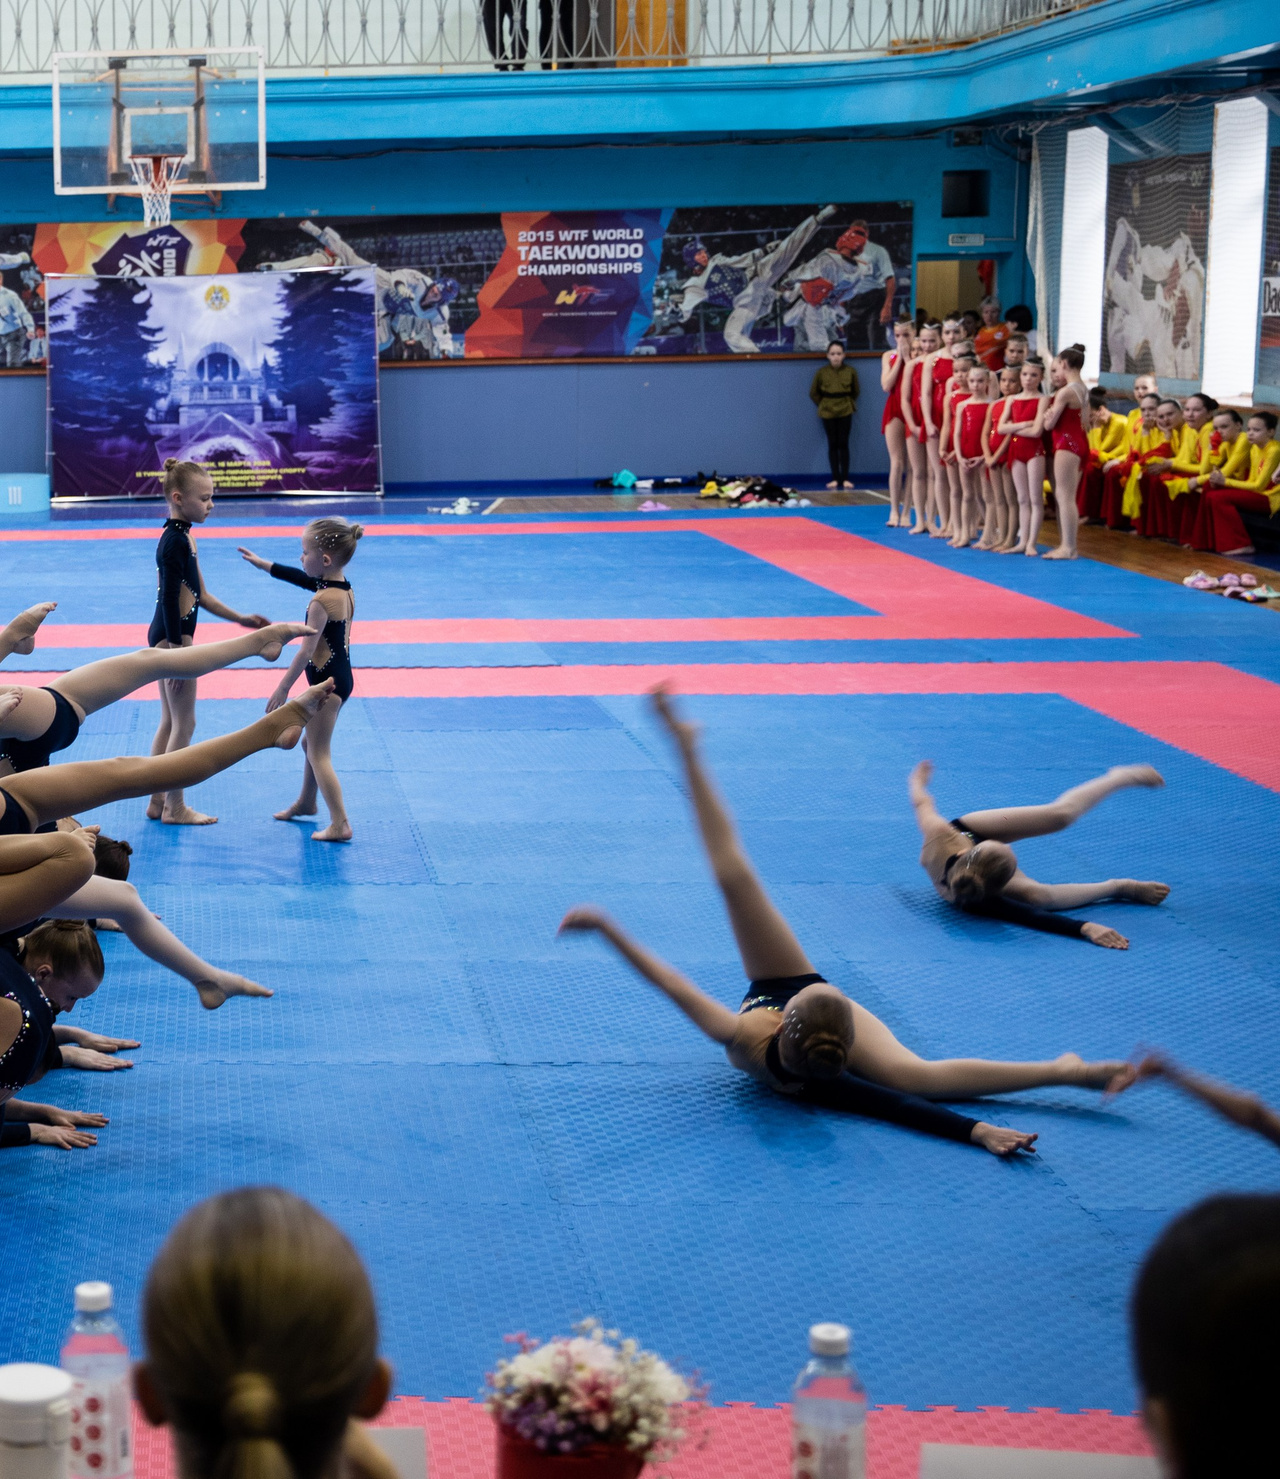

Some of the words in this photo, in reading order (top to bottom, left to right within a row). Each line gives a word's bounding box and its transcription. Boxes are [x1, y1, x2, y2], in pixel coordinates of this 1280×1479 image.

[518, 231, 554, 242] 2015
[558, 229, 589, 241] WTF
[592, 228, 643, 240] WORLD
[517, 243, 643, 261] TAEKWONDO
[517, 262, 643, 276] CHAMPIONSHIPS
[8, 486, 22, 505] III
